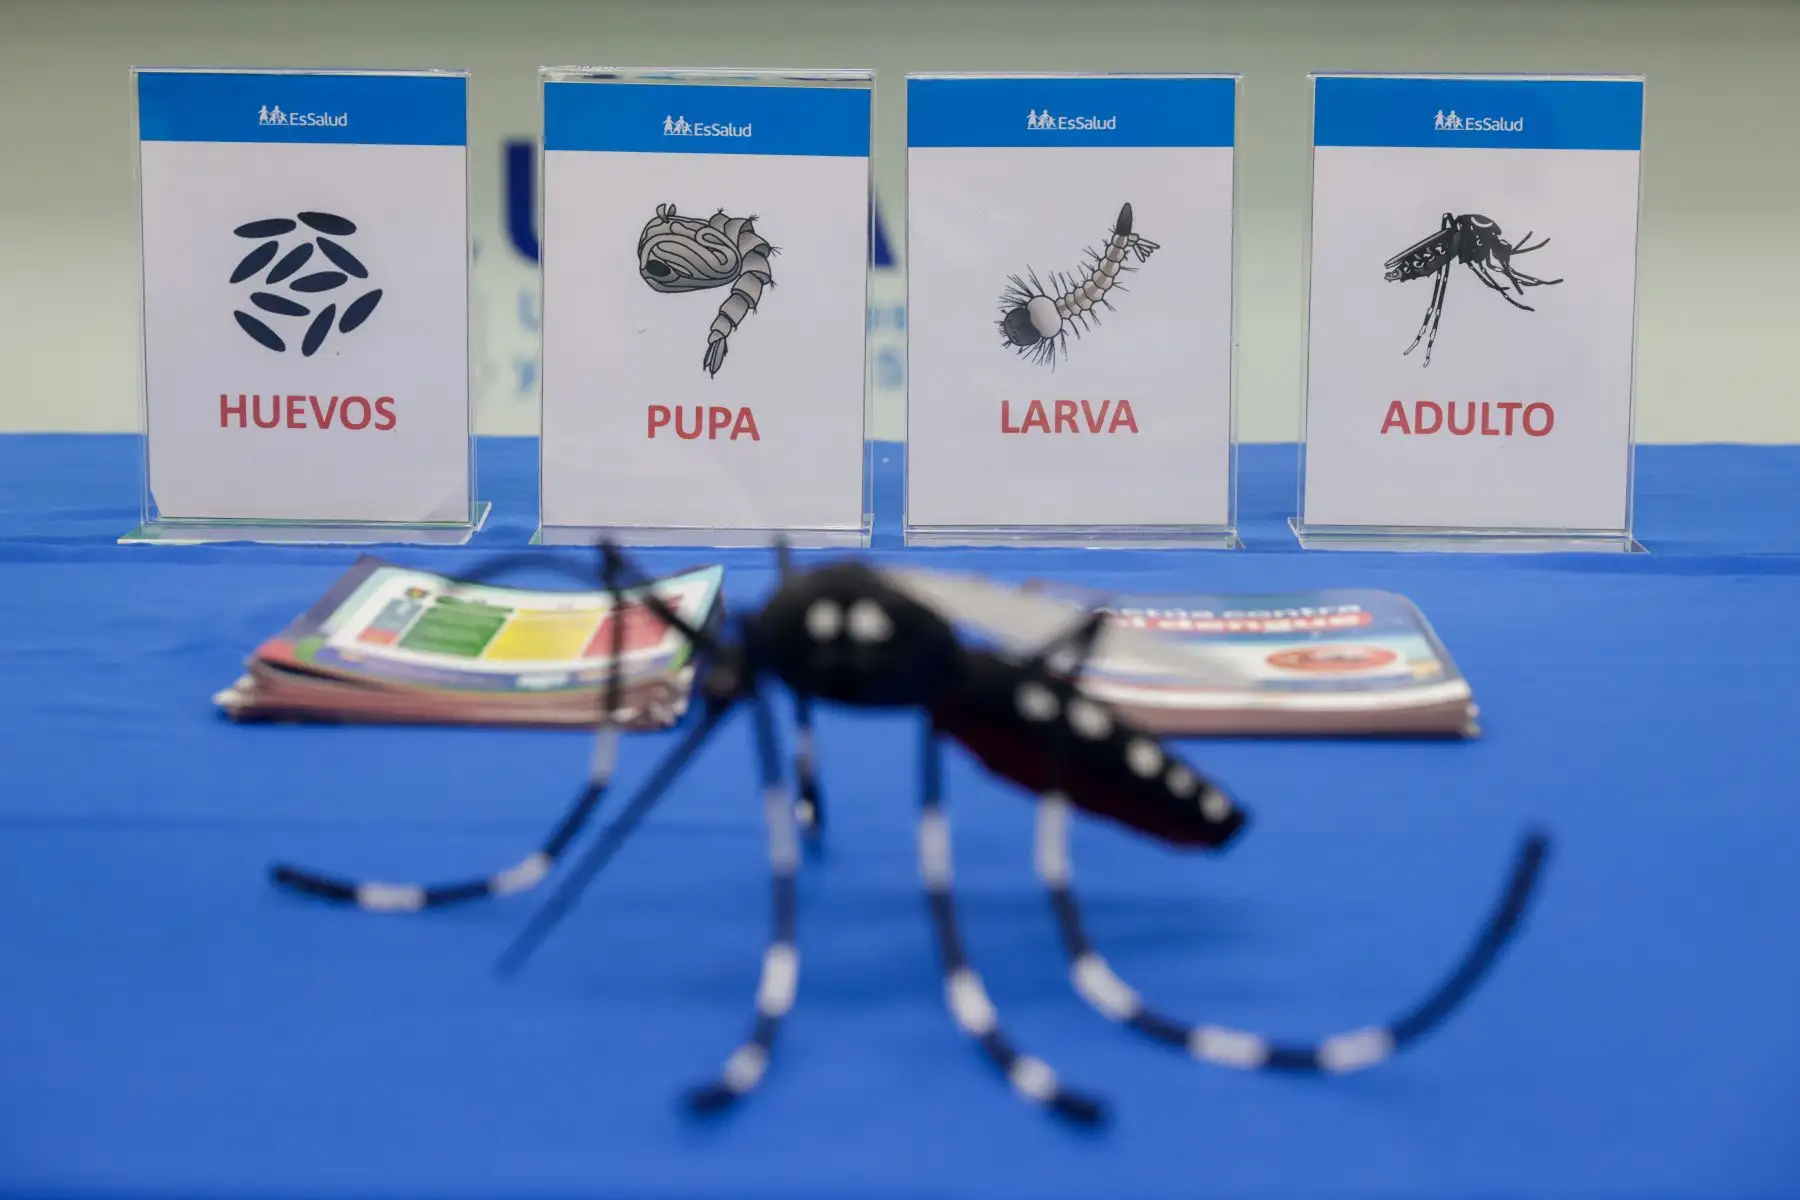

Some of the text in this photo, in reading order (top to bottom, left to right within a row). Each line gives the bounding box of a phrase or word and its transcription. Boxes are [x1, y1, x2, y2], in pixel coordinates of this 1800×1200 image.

[289, 112, 348, 127] EsSalud
[694, 122, 752, 137] EsSalud
[1058, 115, 1116, 130] EsSalud
[1465, 117, 1524, 132] EsSalud
[220, 394, 397, 431] HUEVOS
[648, 404, 760, 440] PUPA
[1002, 400, 1138, 434] LARVA
[1381, 400, 1556, 437] ADULTO
